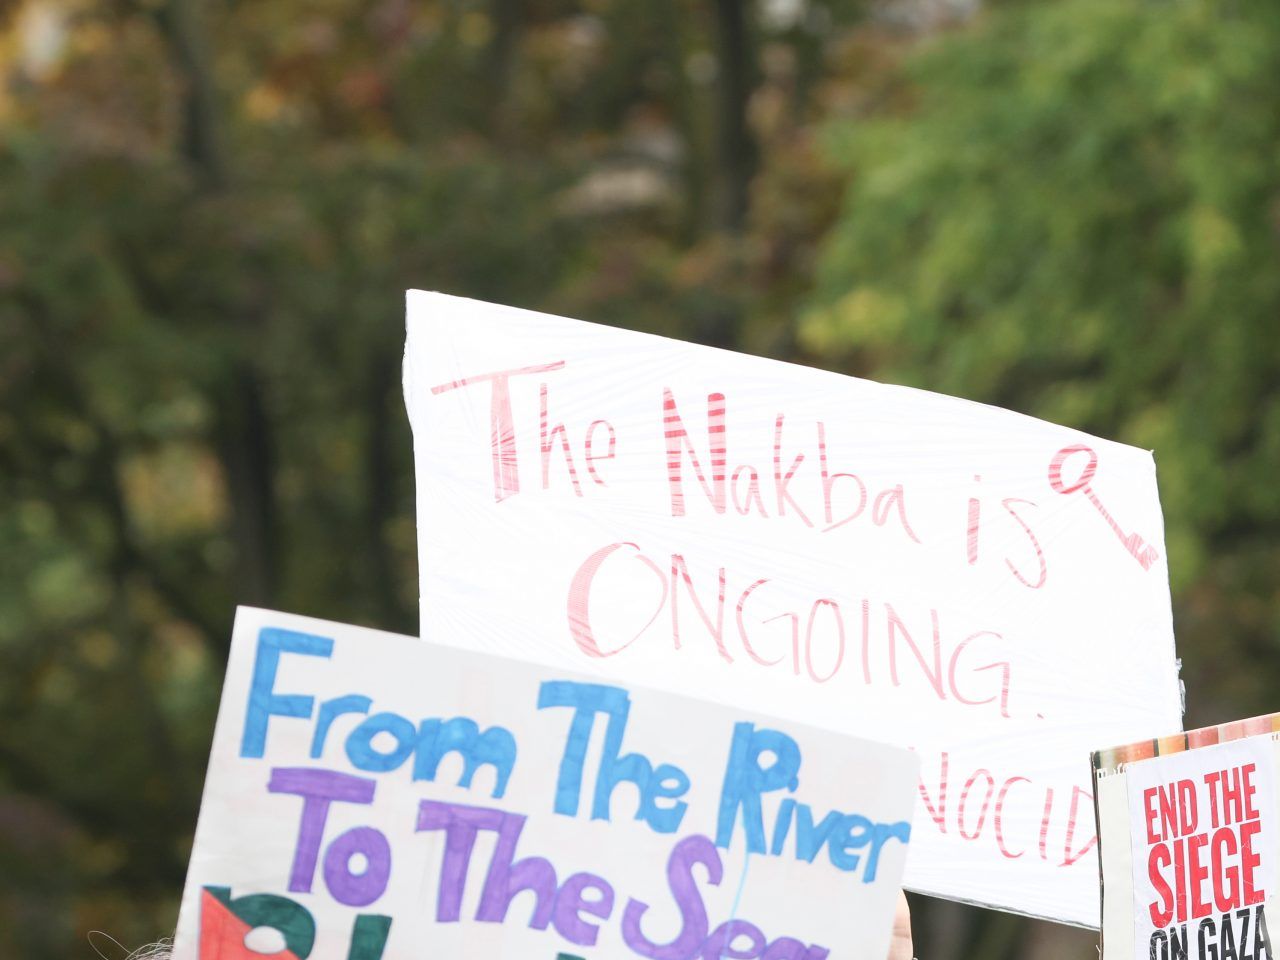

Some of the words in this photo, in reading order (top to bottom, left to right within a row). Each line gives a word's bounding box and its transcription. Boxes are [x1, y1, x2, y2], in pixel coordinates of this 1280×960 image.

[431, 360, 618, 504] The
[663, 386, 922, 544] Nakba
[966, 474, 1048, 588] is
[567, 541, 1047, 719] ONGOING.
[239, 626, 518, 798] From
[538, 680, 691, 834] The
[715, 721, 911, 884] River
[1143, 778, 1199, 845] END
[1204, 763, 1260, 828] THE
[267, 767, 392, 907] To
[415, 799, 614, 946] The
[1147, 820, 1266, 929] SIEGE
